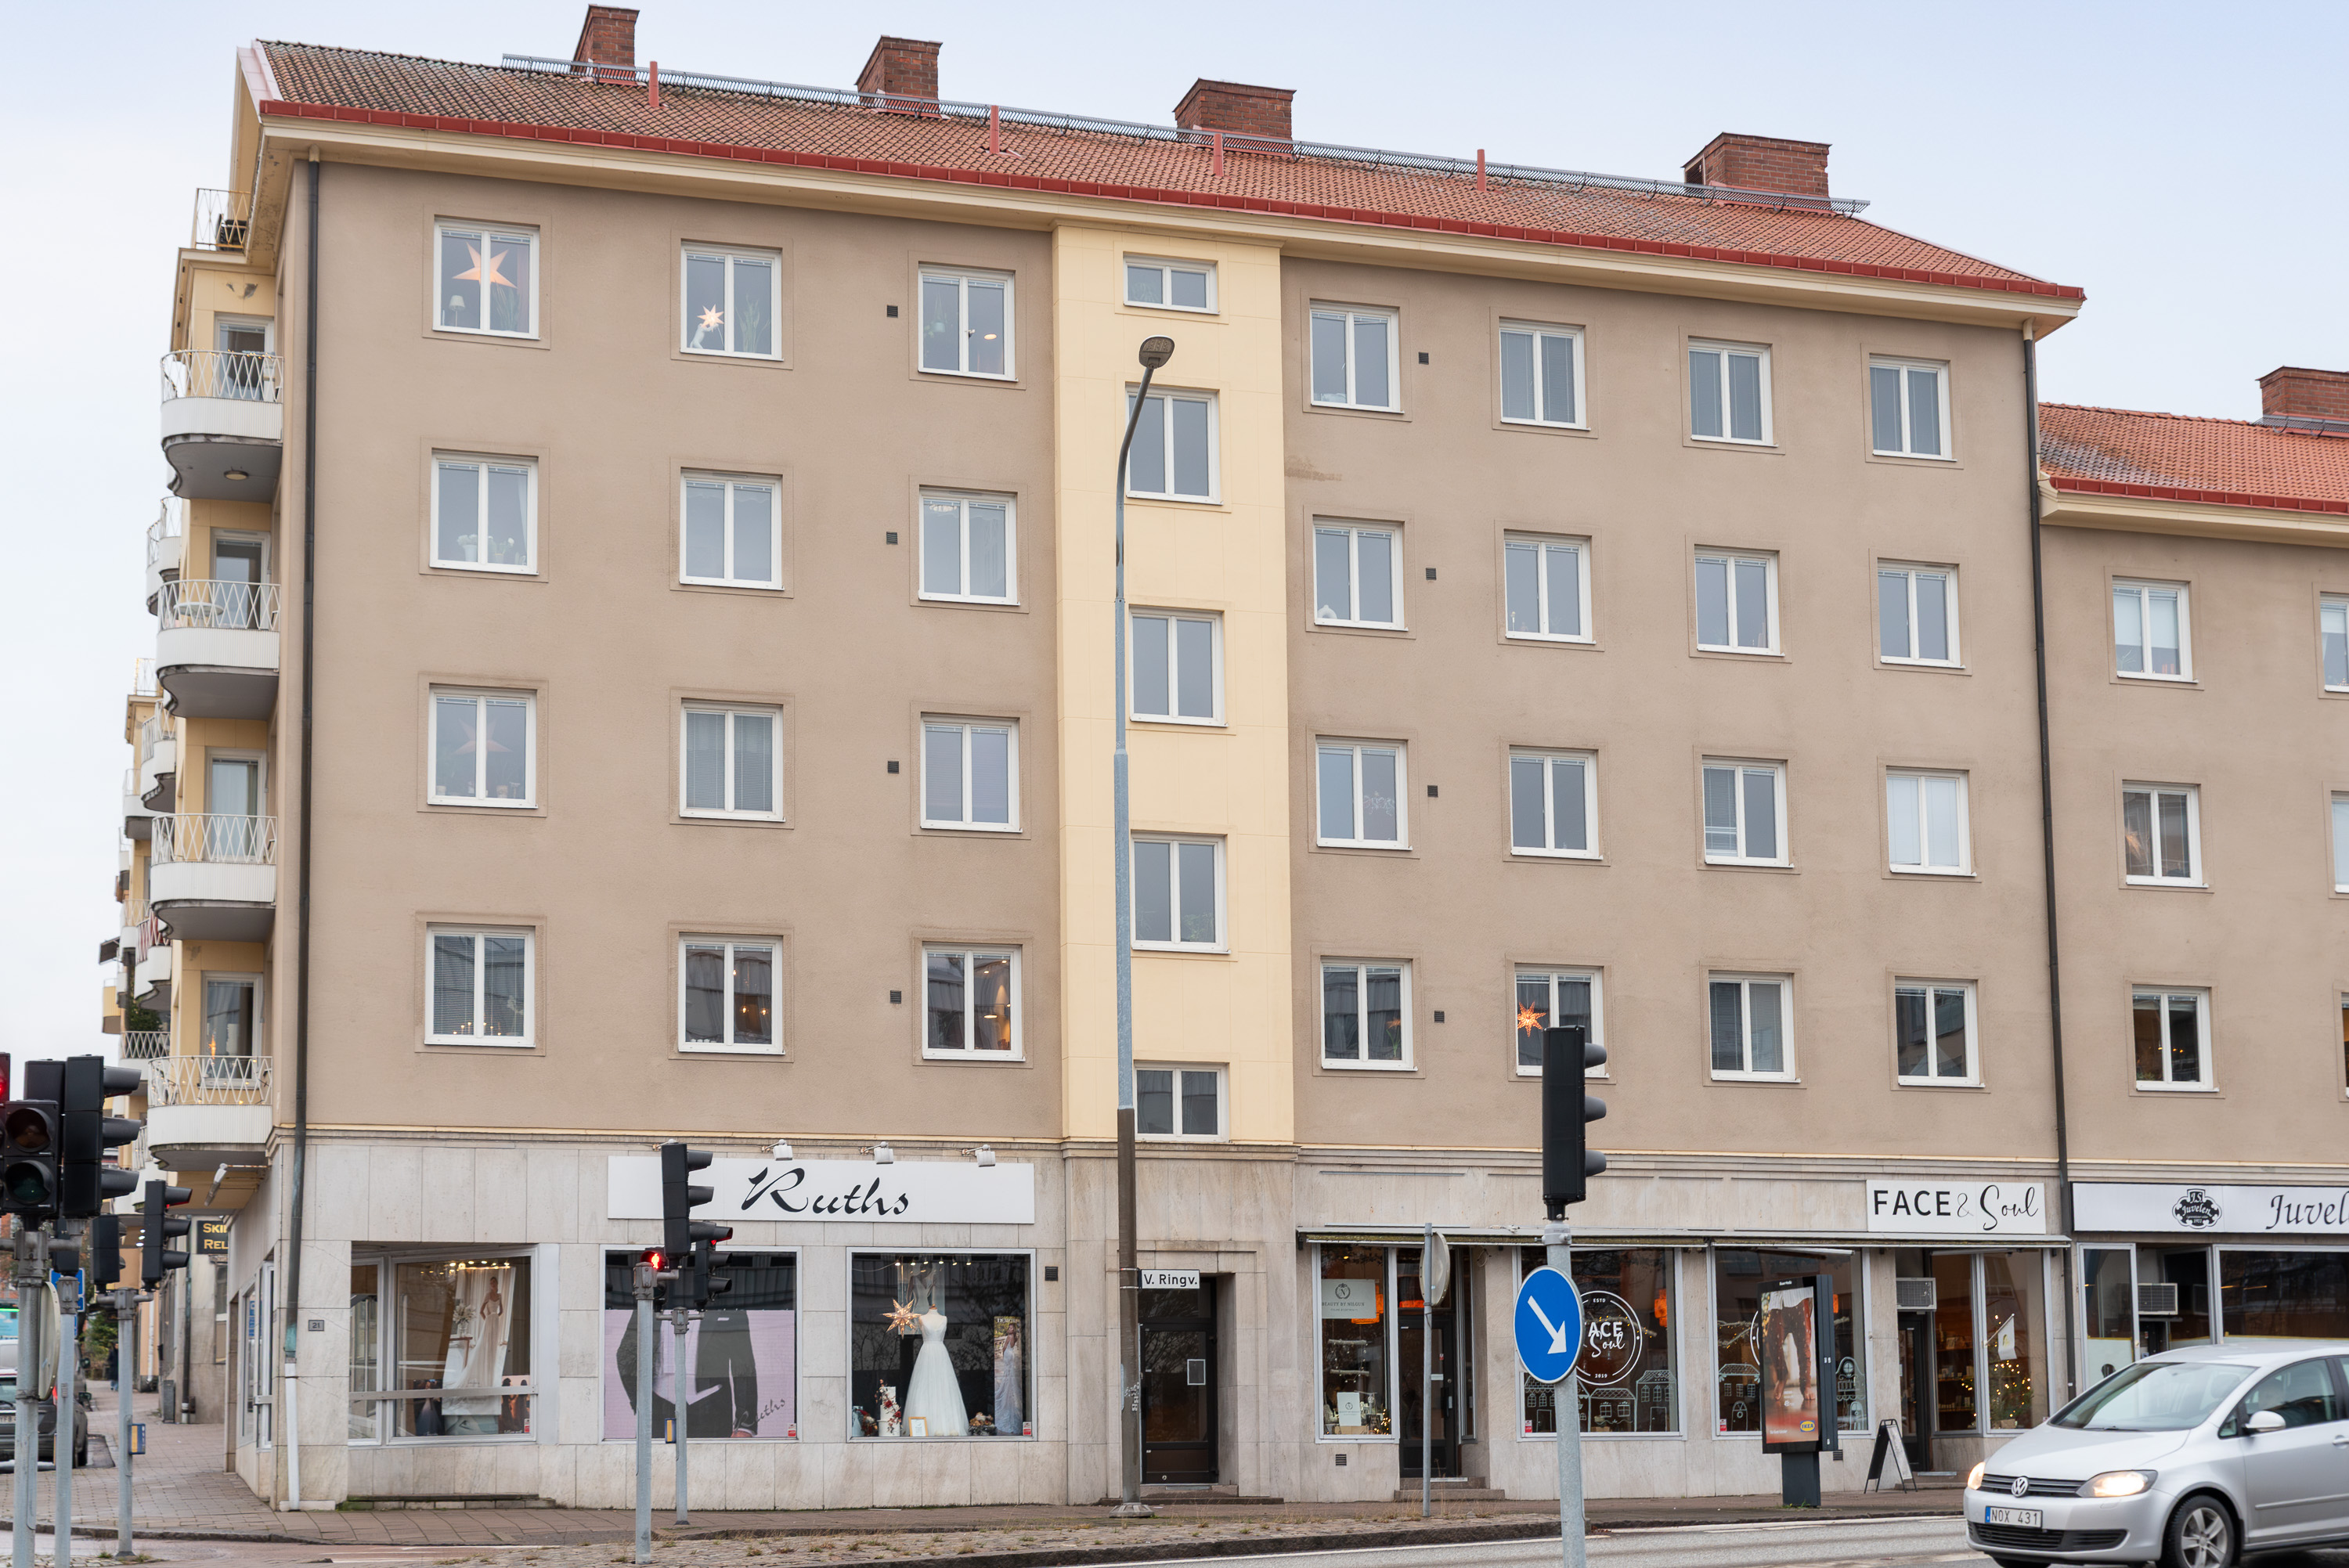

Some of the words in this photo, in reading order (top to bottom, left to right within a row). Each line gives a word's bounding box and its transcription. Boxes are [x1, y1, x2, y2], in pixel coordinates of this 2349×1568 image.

[741, 1166, 909, 1216] Ruths
[1874, 1190, 1951, 1217] FACE
[1958, 1193, 1974, 1218] &
[1979, 1184, 2039, 1231] Soul
[2181, 1203, 2213, 1217] Juvelen
[1143, 1274, 1155, 1285] V.
[1159, 1274, 1198, 1288] Ringv.
[1585, 1321, 1622, 1337] ACE
[1589, 1331, 1626, 1357] Soul
[1991, 1509, 2010, 1523] NOX
[2017, 1511, 2037, 1526] 431
